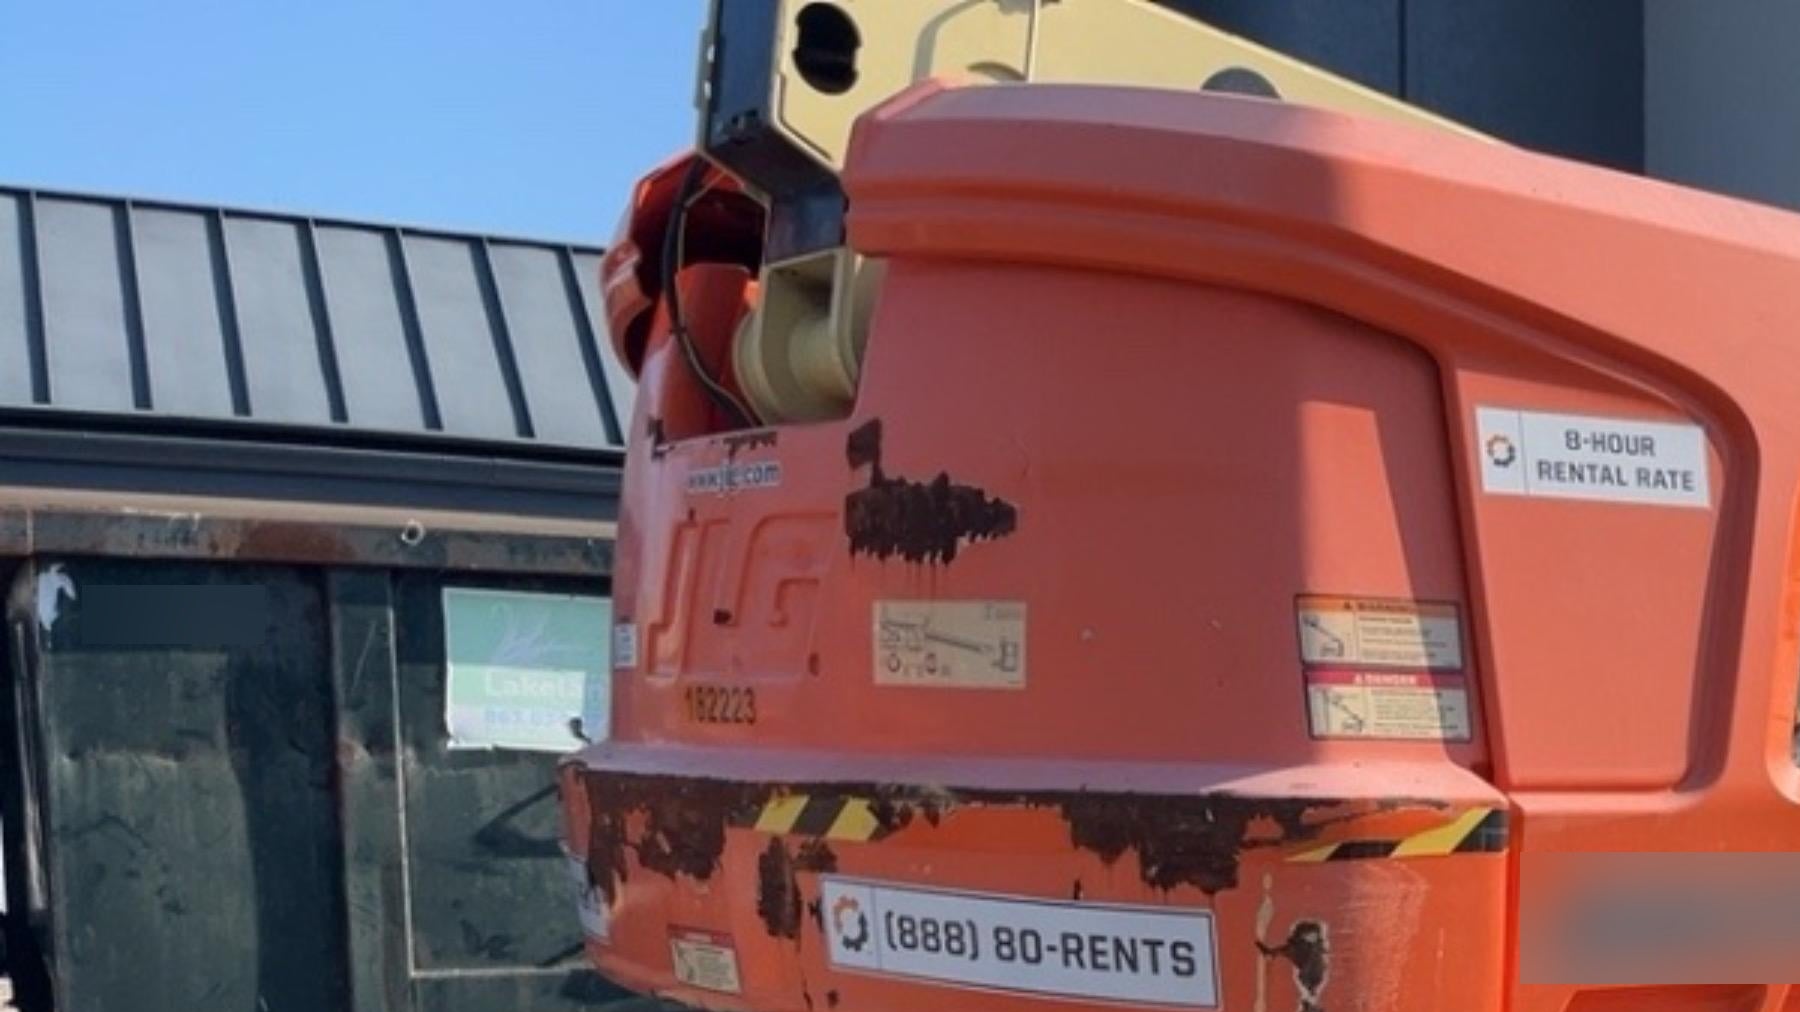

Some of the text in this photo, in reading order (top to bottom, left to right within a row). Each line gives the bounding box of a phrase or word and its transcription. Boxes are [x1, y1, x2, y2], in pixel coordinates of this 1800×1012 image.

[1564, 428, 1656, 457] 8-HOUR
[1536, 460, 1696, 492] RENTAL RATE
[684, 686, 757, 724] 182223
[886, 910, 1197, 979] (888) 80-RENTS
